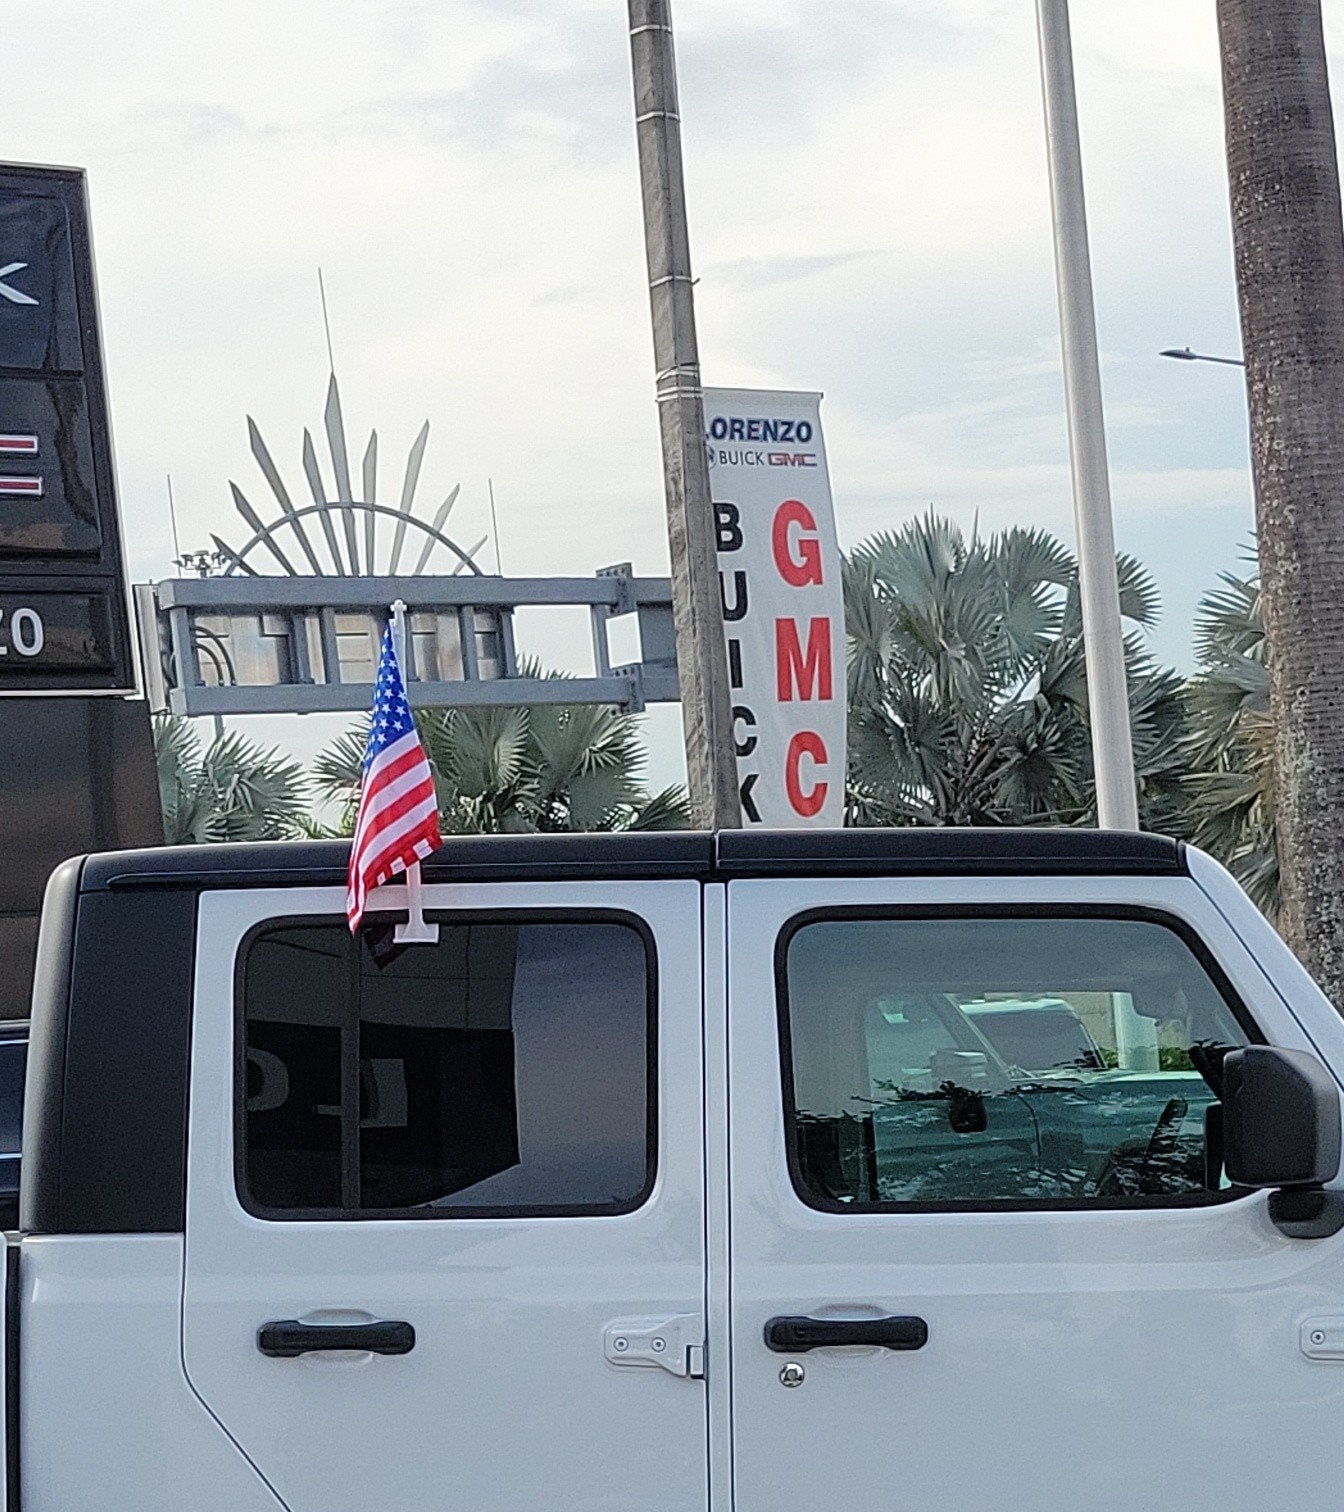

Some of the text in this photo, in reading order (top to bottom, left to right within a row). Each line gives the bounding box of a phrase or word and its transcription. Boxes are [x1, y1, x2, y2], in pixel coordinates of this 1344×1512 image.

[706, 417, 813, 442] ORENZO
[719, 450, 818, 467] BUICK GMC
[772, 499, 833, 817] GMC
